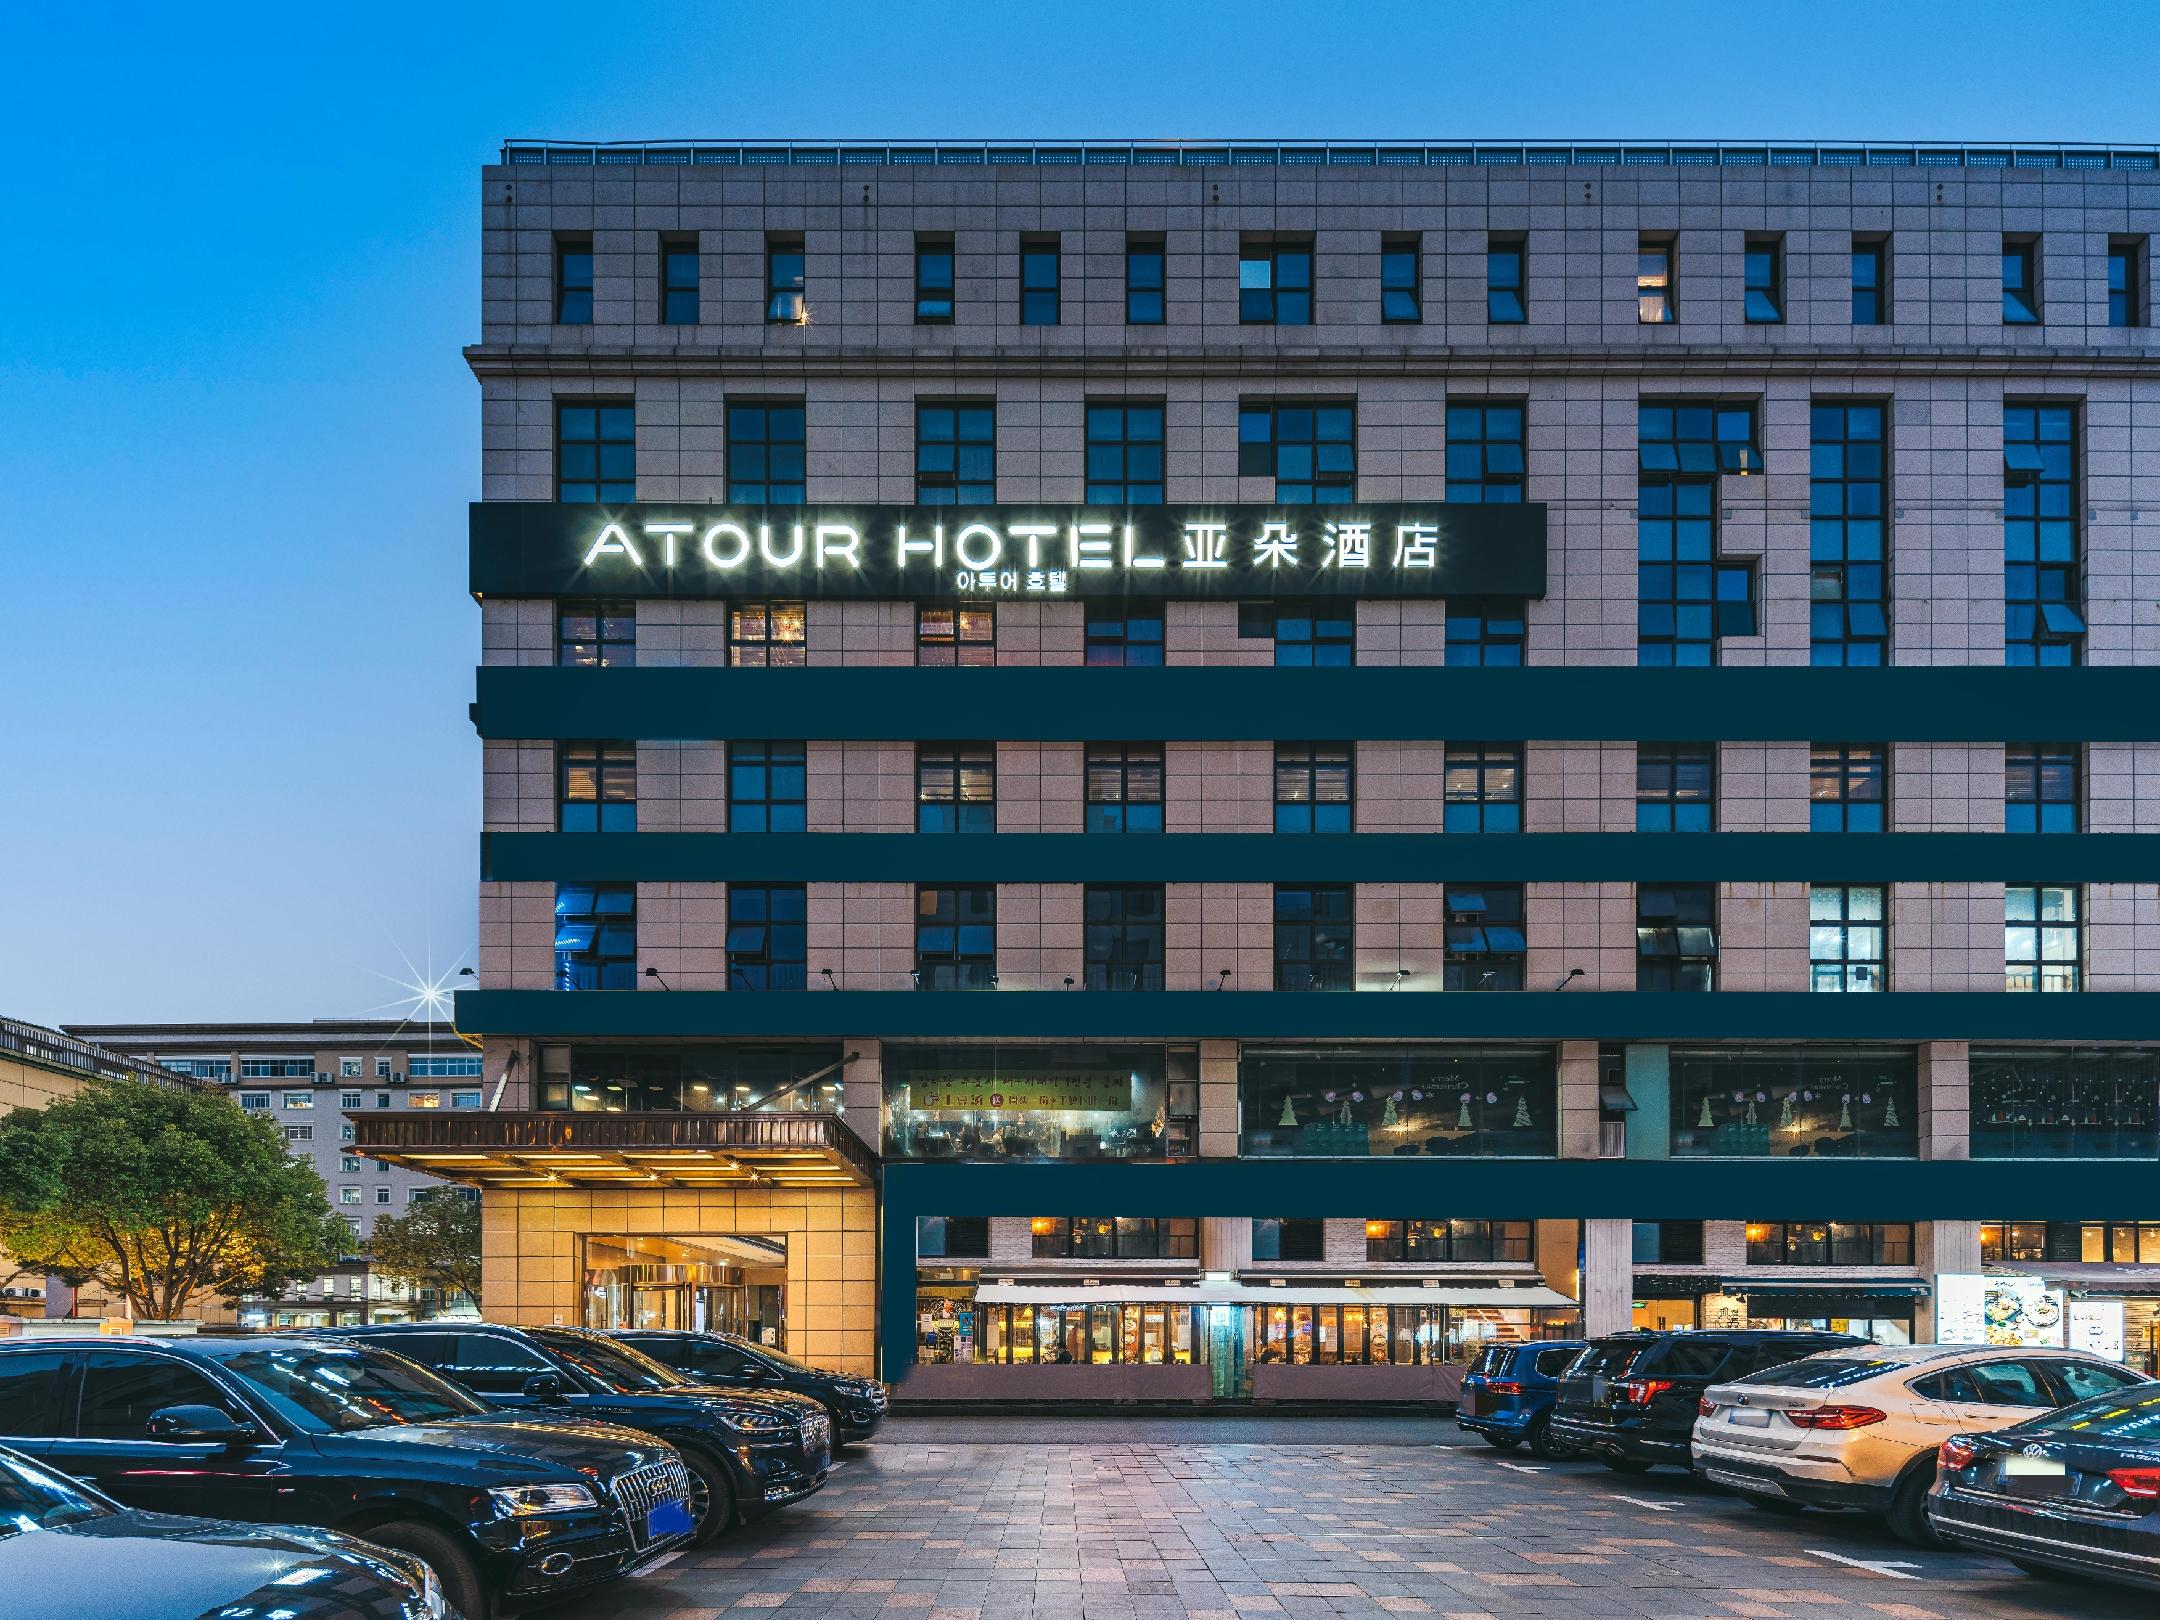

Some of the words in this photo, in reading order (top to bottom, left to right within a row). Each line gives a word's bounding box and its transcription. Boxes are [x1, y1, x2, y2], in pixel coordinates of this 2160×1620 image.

[585, 523, 860, 568] ATOUR
[898, 524, 1165, 570] HOTEL
[1183, 522, 1438, 568] 亚朵酒店
[957, 571, 1017, 592] 아투어
[1027, 571, 1067, 592] 호텔
